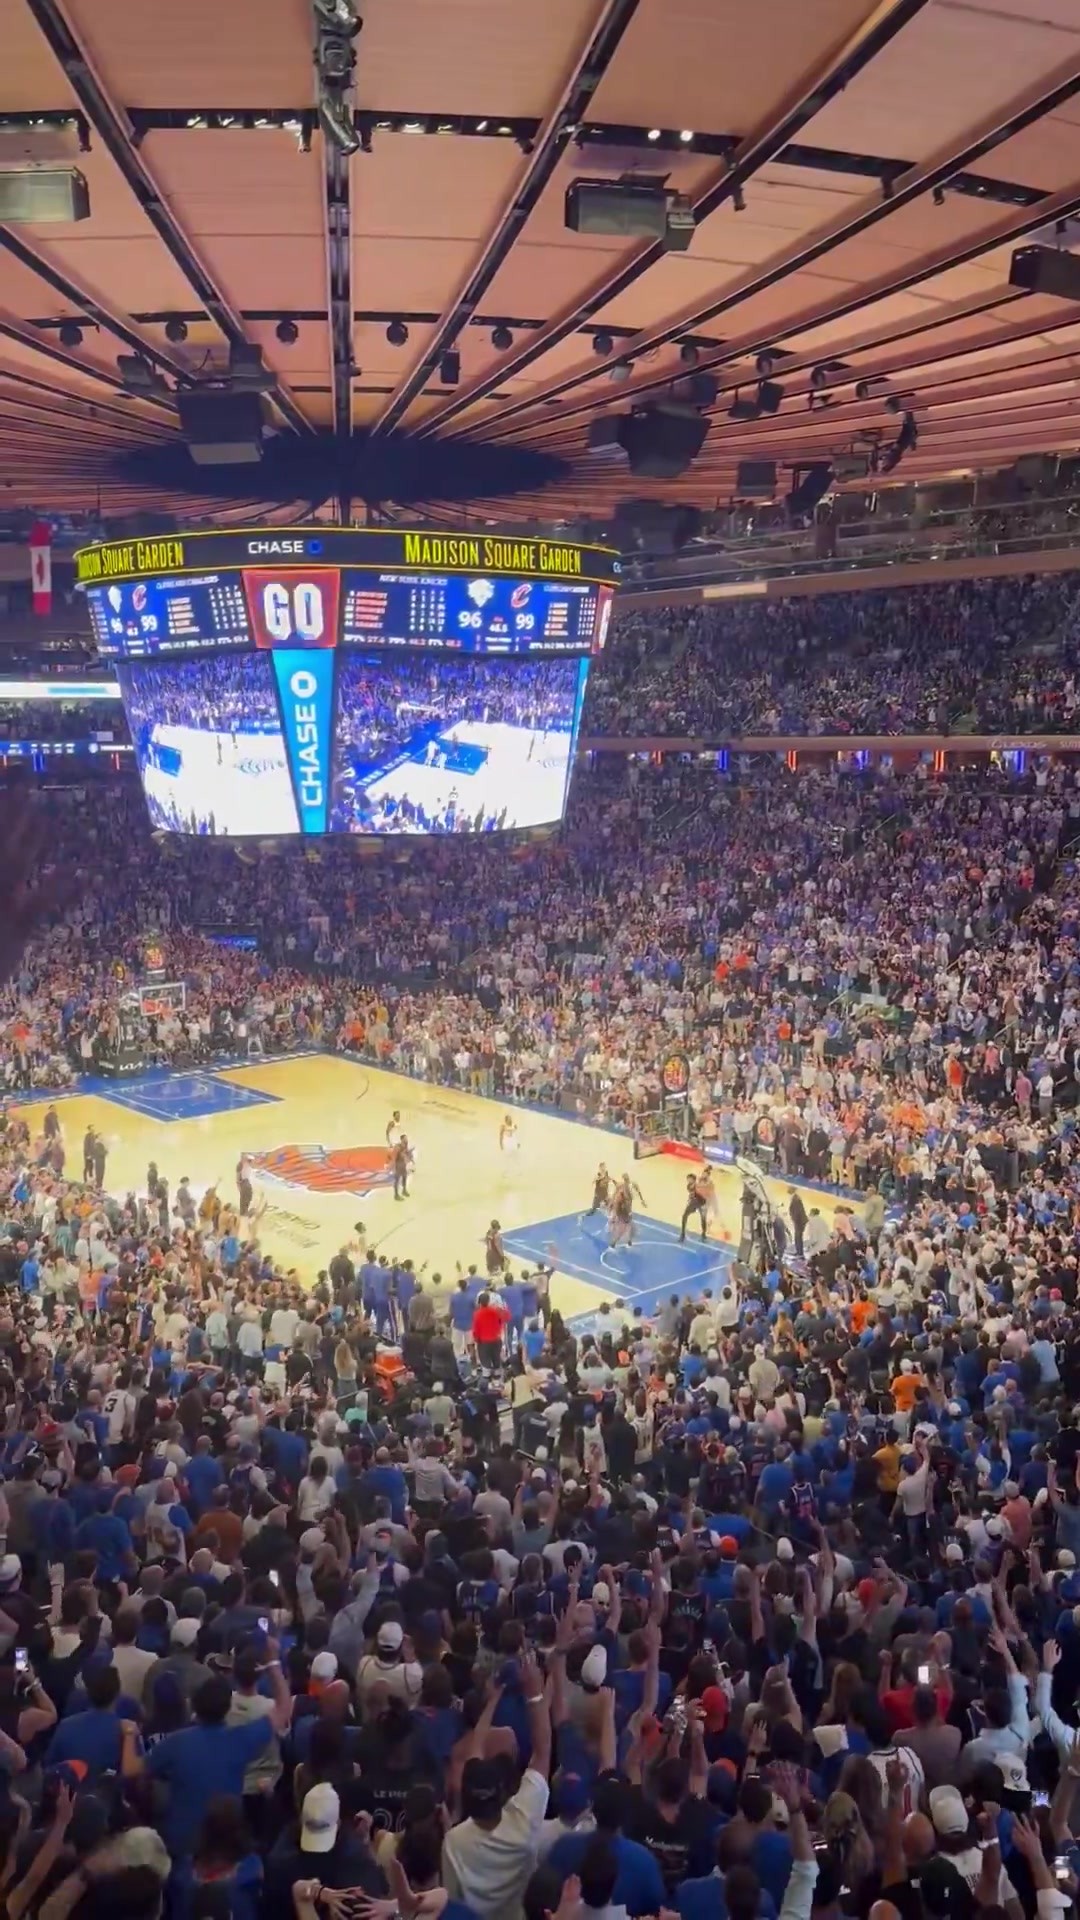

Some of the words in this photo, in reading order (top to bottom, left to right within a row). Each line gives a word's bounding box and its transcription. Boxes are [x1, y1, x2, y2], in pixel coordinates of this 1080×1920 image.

[248, 540, 303, 554] CHASE
[405, 534, 479, 566] MADISON
[484, 539, 536, 570] SQUARE
[539, 543, 581, 574] GARDEN
[101, 547, 135, 574] SQUARE
[137, 542, 183, 570] GARDEN
[263, 583, 324, 640] GO
[458, 611, 482, 628] 96
[140, 614, 158, 632] 99
[516, 613, 534, 629] 99
[295, 704, 322, 806] CHASE
[105, 1398, 117, 1412] 3
